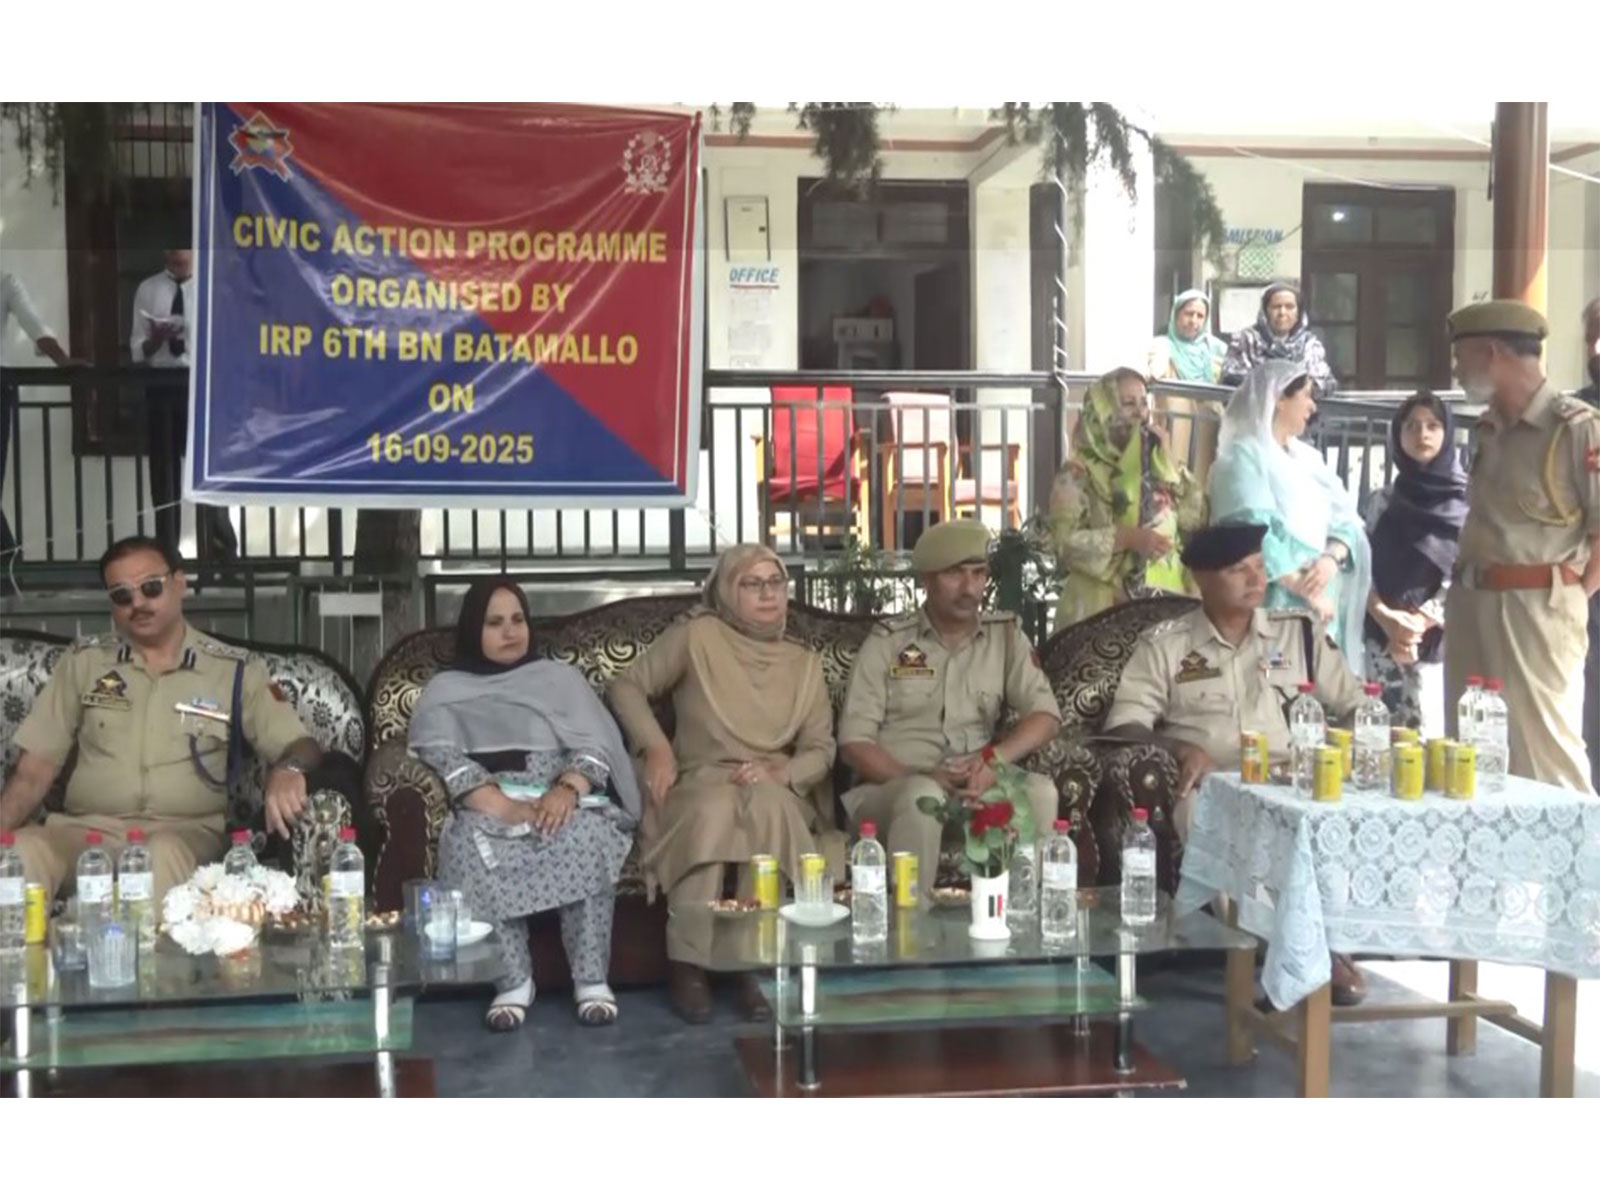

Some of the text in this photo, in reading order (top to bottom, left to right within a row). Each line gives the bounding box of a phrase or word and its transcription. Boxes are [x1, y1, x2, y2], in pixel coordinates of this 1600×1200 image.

[233, 216, 667, 262] CIVIC ACTION PROGRAMME
[1224, 228, 1284, 244] MISSION
[729, 267, 779, 283] OFFICE
[331, 274, 573, 313] ORGANISED BY
[259, 324, 638, 364] IRP 6TH BN BATAMALLO
[429, 383, 474, 413] ON
[367, 432, 534, 463] 16-09-2025
